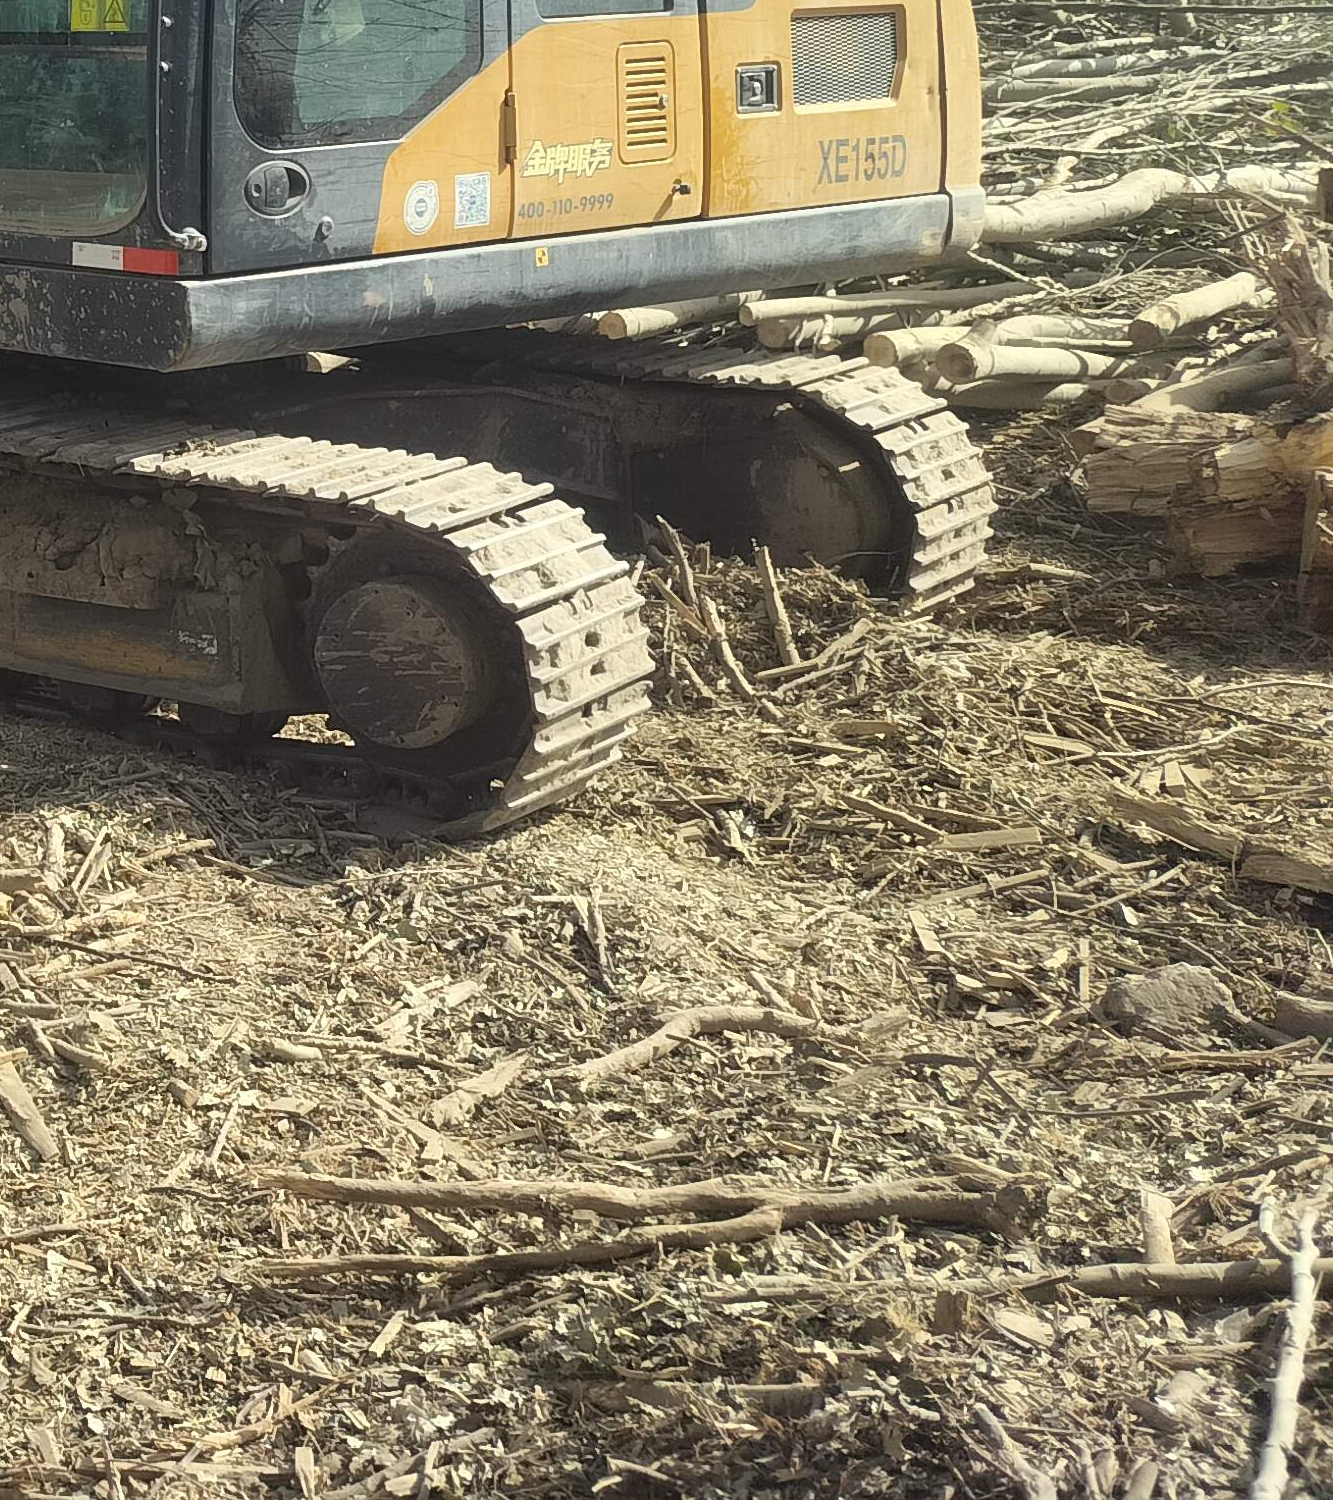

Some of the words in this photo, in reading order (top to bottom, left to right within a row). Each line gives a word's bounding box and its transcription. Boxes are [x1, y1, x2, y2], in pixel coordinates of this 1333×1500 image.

[519, 137, 613, 187] 金牌服务
[817, 134, 907, 185] XE155D
[517, 192, 614, 220] 400-110-9999
